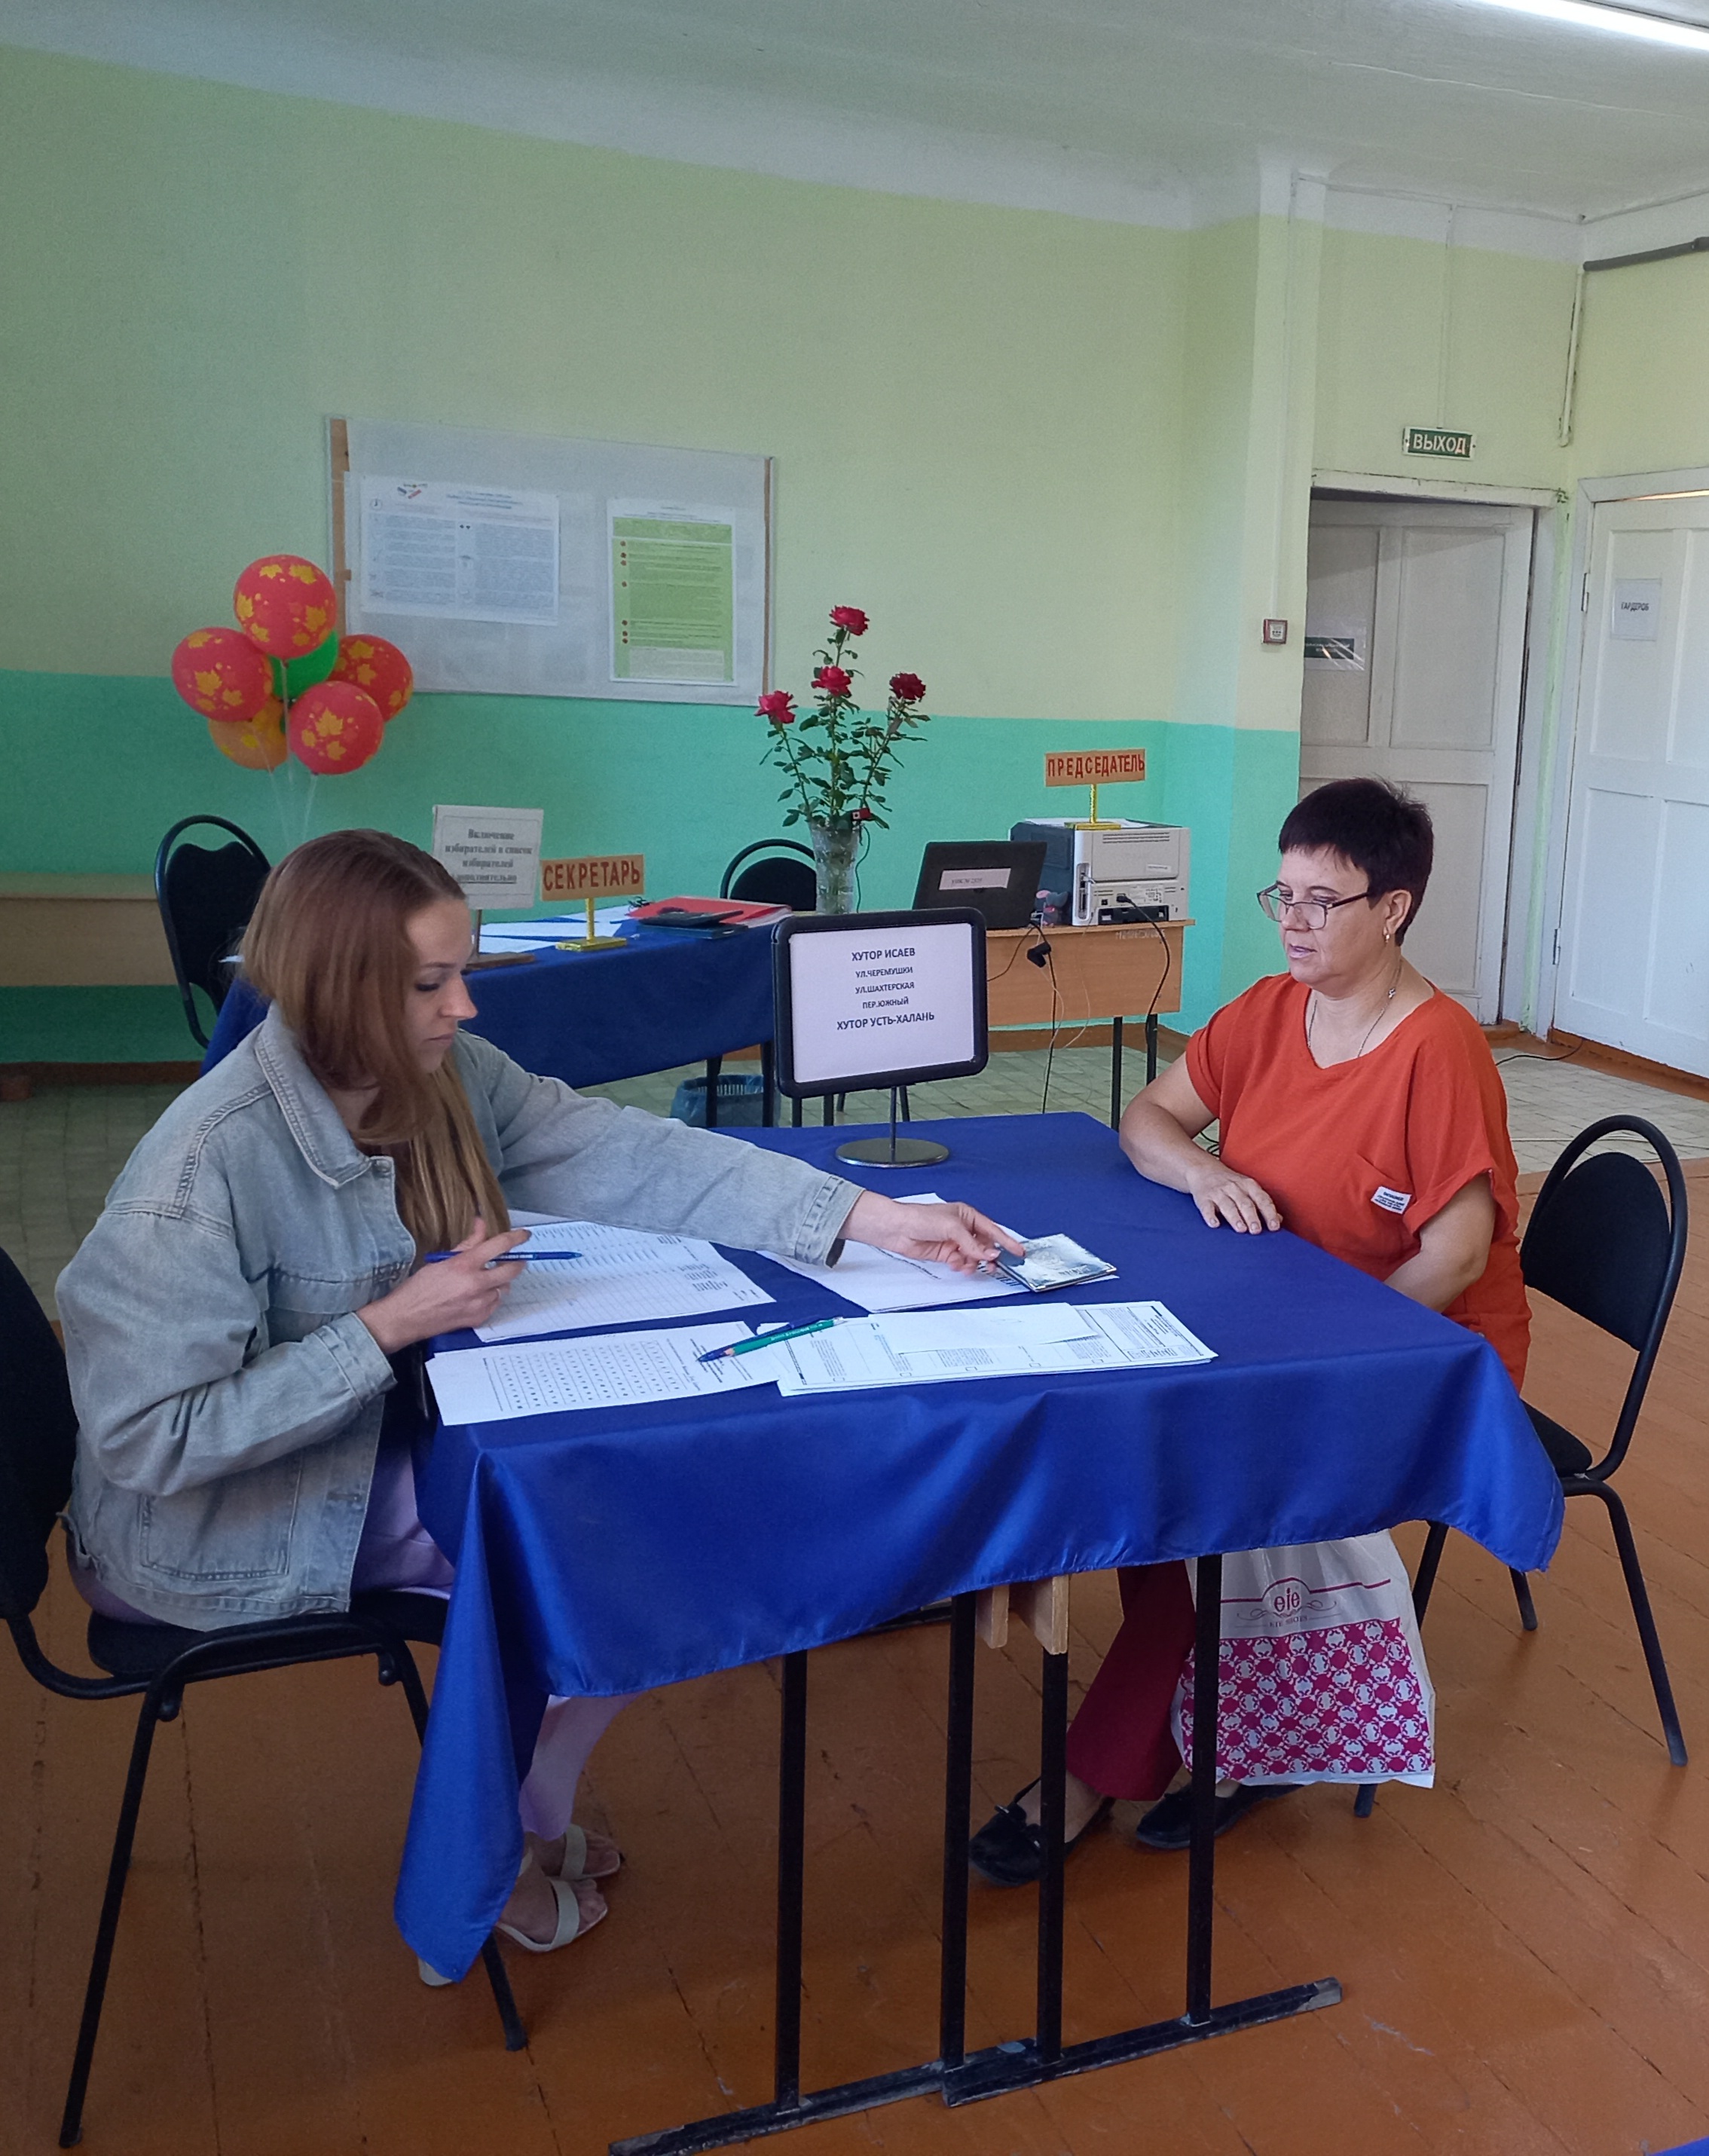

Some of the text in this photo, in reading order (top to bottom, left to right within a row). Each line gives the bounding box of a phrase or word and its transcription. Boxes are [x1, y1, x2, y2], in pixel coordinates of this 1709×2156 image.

[1413, 433, 1466, 455] ВЫХОД
[1047, 754, 1145, 778] ПРЕДСЕДАТЕЛЬ
[543, 860, 640, 891] СЕКРЕТАРЬ
[851, 947, 916, 962] ХУТОР ИСАЕВ
[855, 966, 913, 978] УЛ.ЧЕРЕМУШКИ
[854, 981, 915, 994] УЛ.ШАХТЕРСКАЯ
[862, 995, 909, 1009] ПЕР.ЮЖНЫЙ
[836, 1011, 935, 1030] ХУТОР УСТЬ-ХАЛАНЬ
